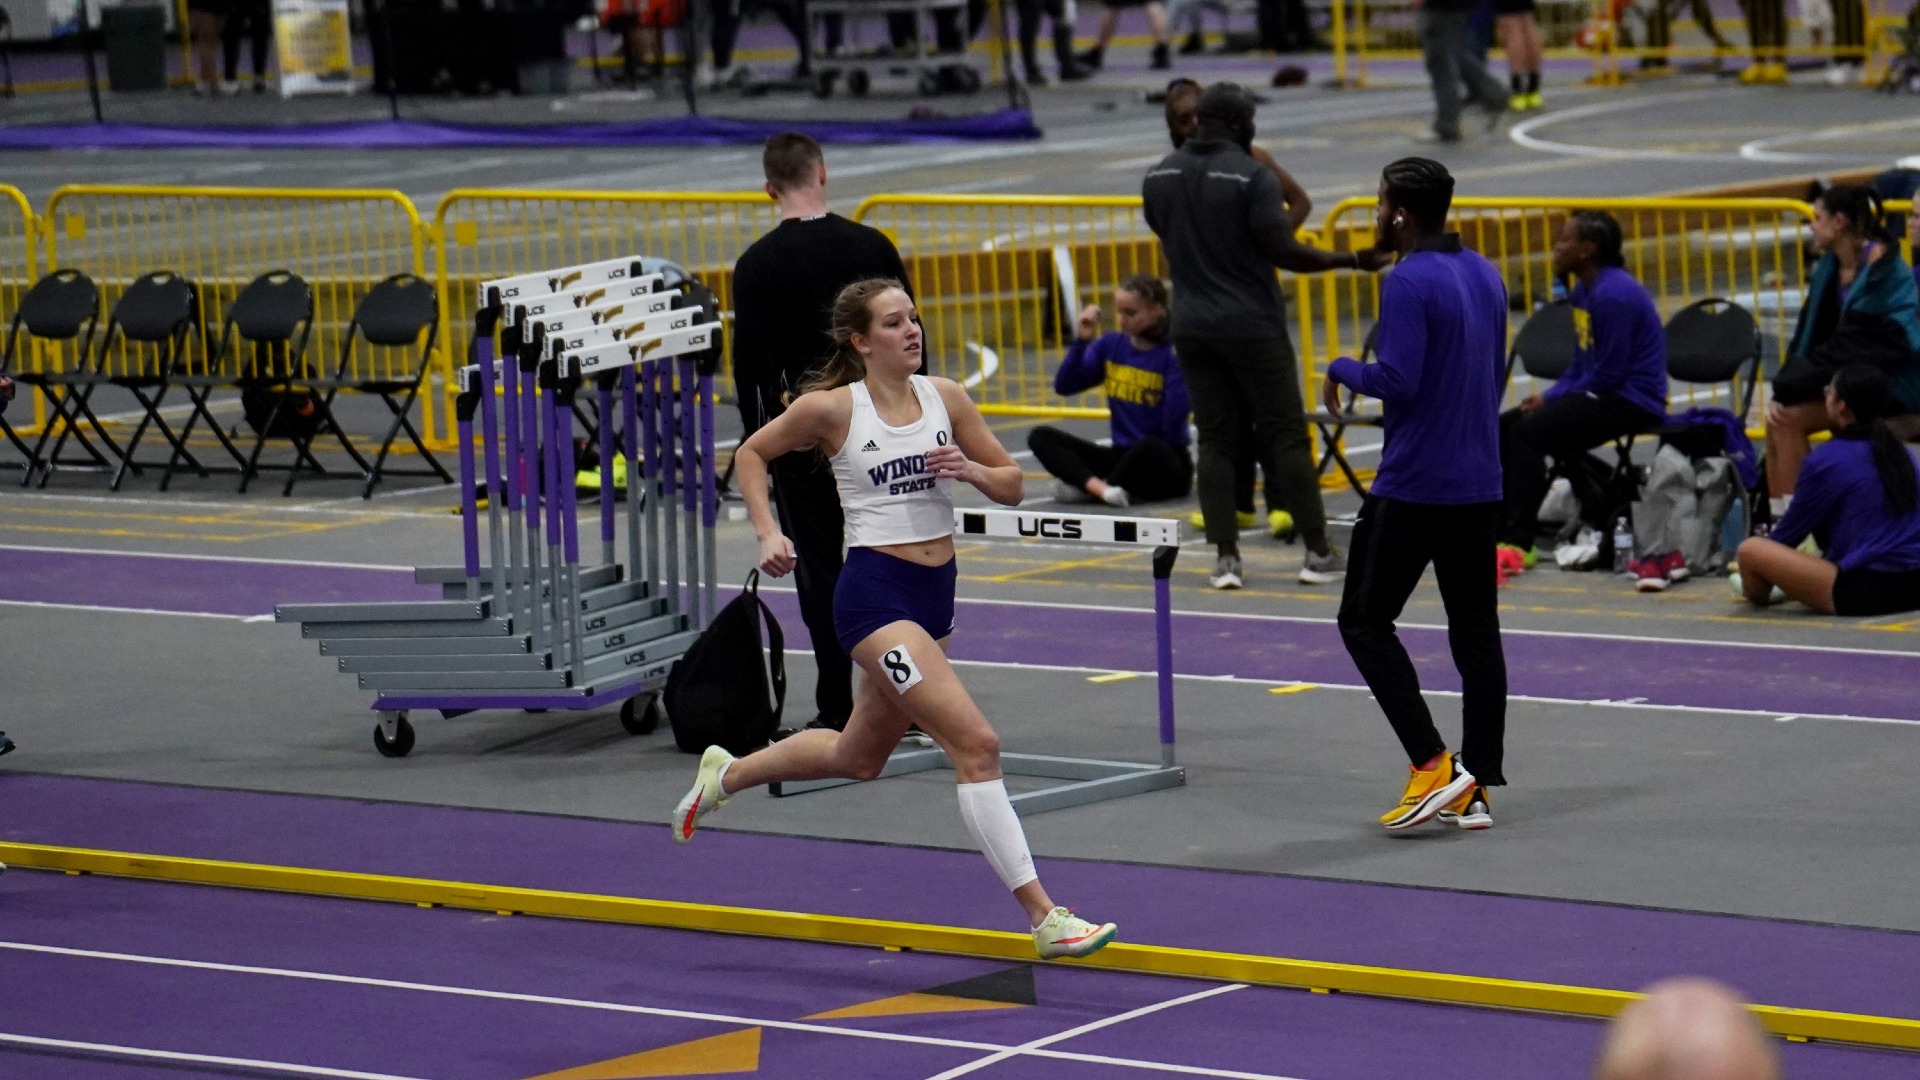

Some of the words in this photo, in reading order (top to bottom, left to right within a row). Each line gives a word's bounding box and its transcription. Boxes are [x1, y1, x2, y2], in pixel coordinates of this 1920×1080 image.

[501, 287, 519, 298] UCS
[608, 268, 625, 279] UCS
[527, 305, 545, 316] UCS
[630, 285, 648, 296] UCS
[546, 322, 563, 333] UCS
[648, 302, 665, 313] UCS
[566, 339, 584, 350] UCS
[670, 319, 687, 330] UCS
[580, 355, 599, 367] UCS
[688, 335, 705, 346] UCS
[868, 451, 940, 486] WINO
[889, 476, 936, 496] STATE
[1018, 516, 1082, 540] UCS
[585, 616, 607, 632] UCS
[604, 634, 625, 649] UCS
[624, 651, 646, 666] UCS
[884, 650, 911, 684] 8
